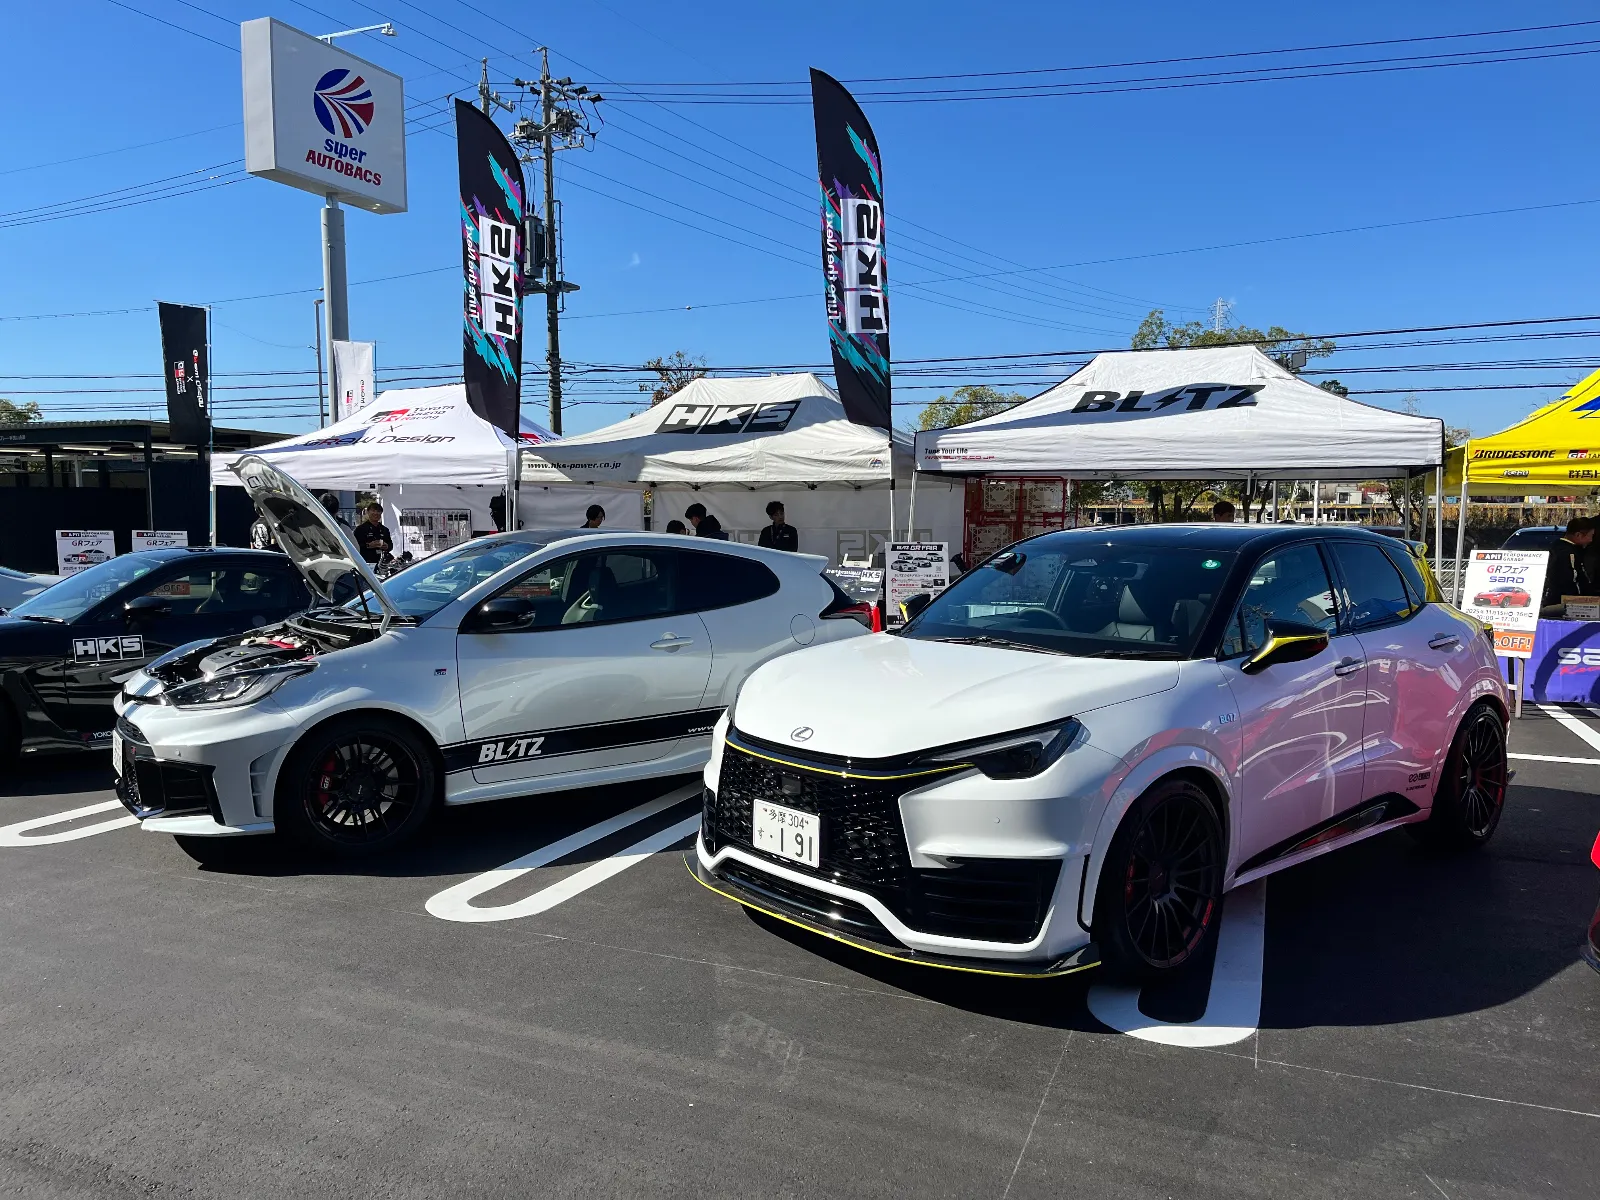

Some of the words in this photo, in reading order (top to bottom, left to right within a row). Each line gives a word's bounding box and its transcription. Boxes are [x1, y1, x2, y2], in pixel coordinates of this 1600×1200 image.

[305, 149, 382, 187] AUTOBACS
[1070, 384, 1266, 414] BLITZ
[662, 403, 796, 428] HKS
[376, 434, 456, 444] Design
[941, 447, 956, 455] Your
[1473, 449, 1556, 459] BRIDGESTONE
[1567, 451, 1588, 459] GR
[527, 461, 622, 470] www.hks-power.co.jp
[1487, 564, 1529, 574] GRフェア
[74, 637, 143, 660] HKS
[92, 731, 113, 739] YOKO
[478, 736, 545, 763] BLITZ
[787, 813, 805, 830] 304
